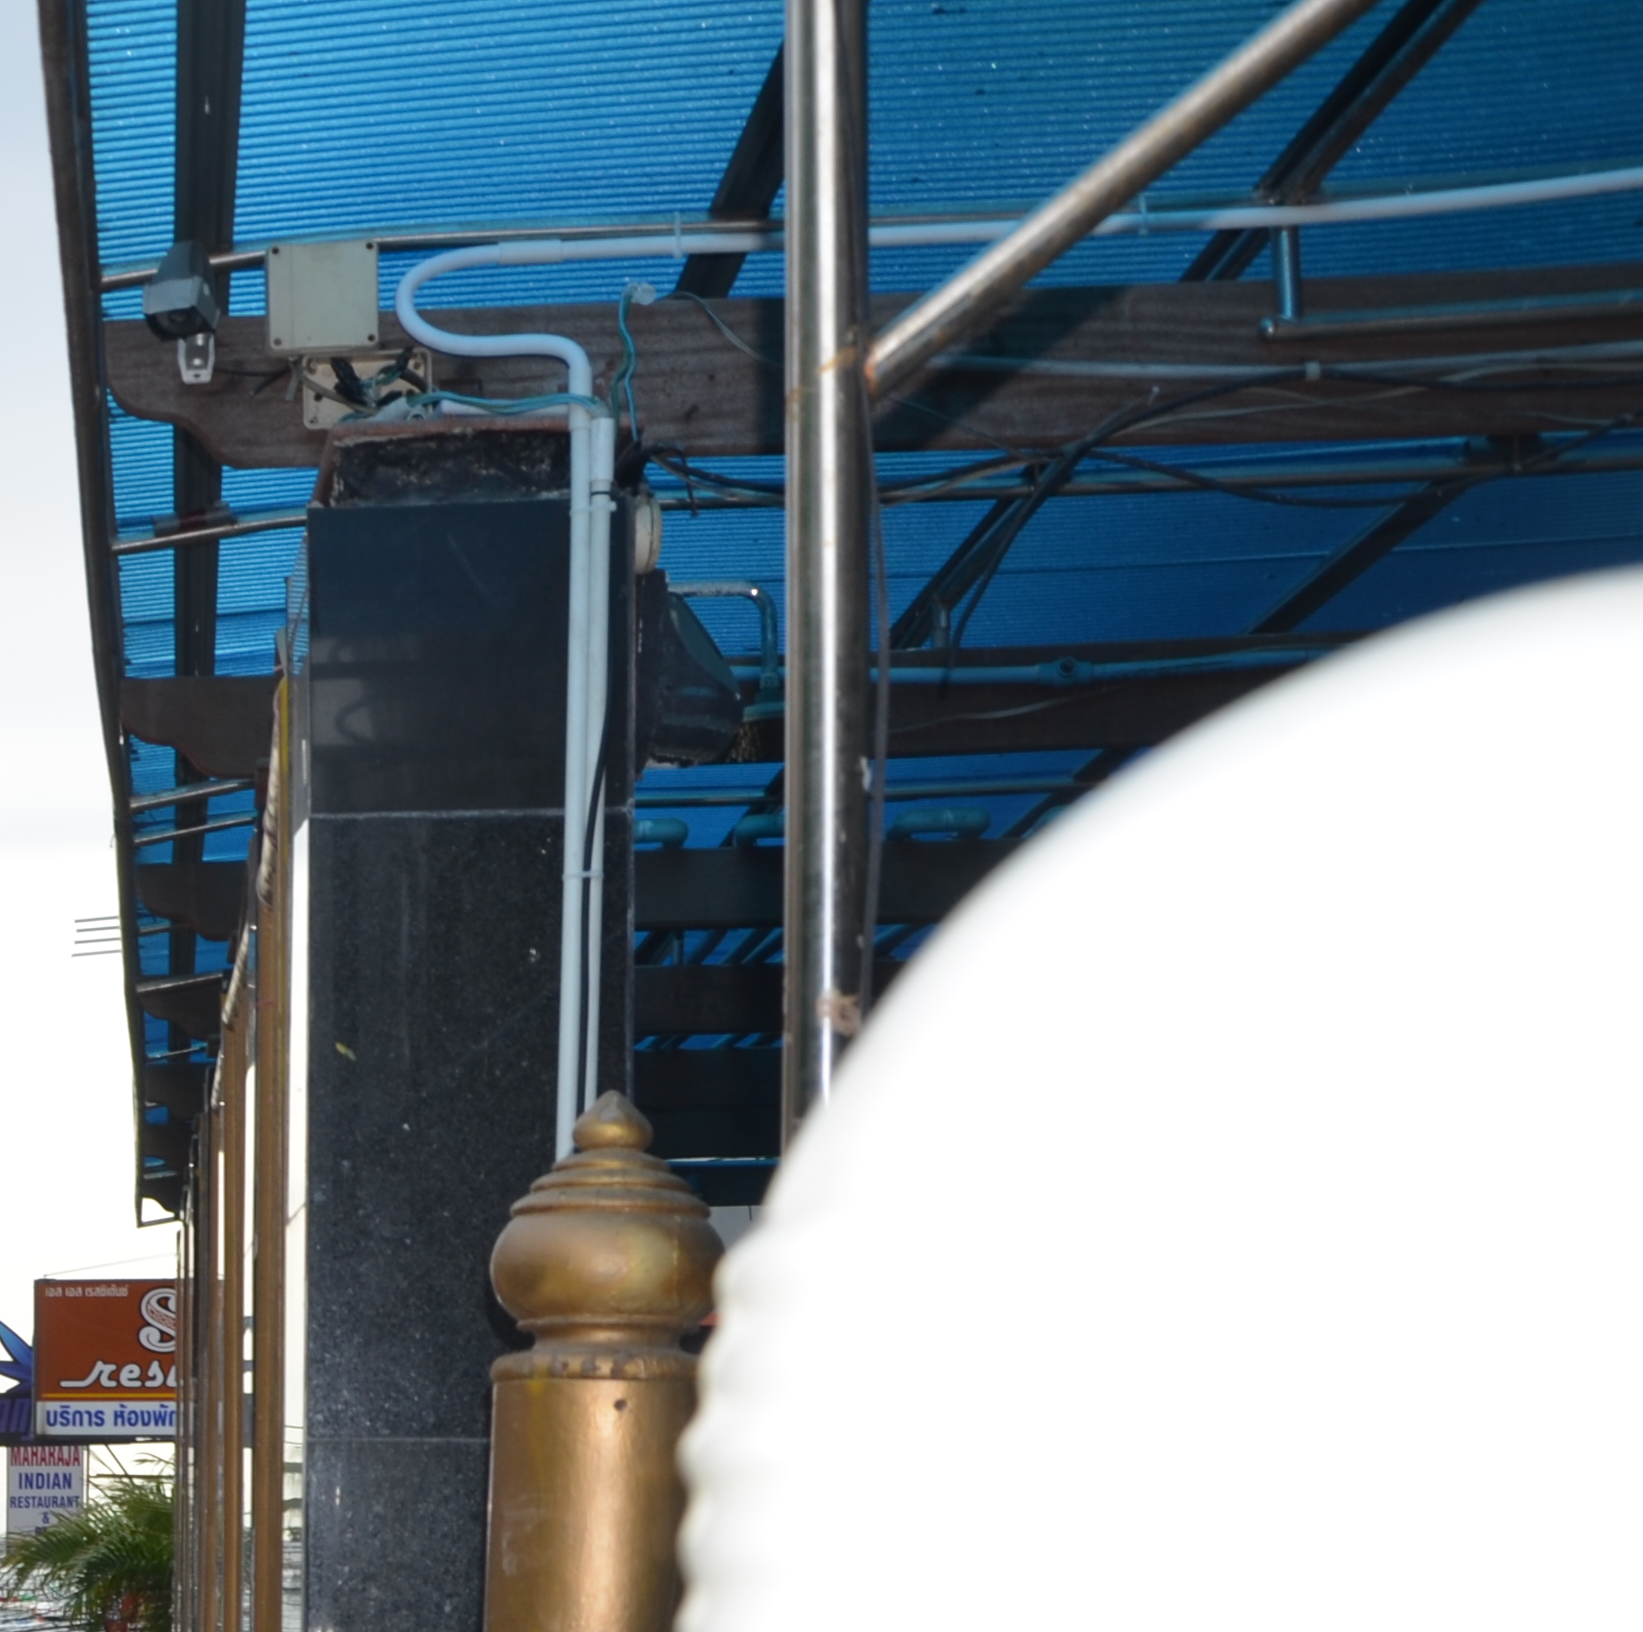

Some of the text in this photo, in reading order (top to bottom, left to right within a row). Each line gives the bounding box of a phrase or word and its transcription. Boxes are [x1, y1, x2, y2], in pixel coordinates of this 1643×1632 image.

[139, 1287, 176, 1353] S
[45, 1404, 105, 1427] บริการ
[11, 1445, 81, 1466] MAHARAJA
[19, 1472, 72, 1490] INDIAN
[10, 1496, 80, 1508] RESTAURANT
